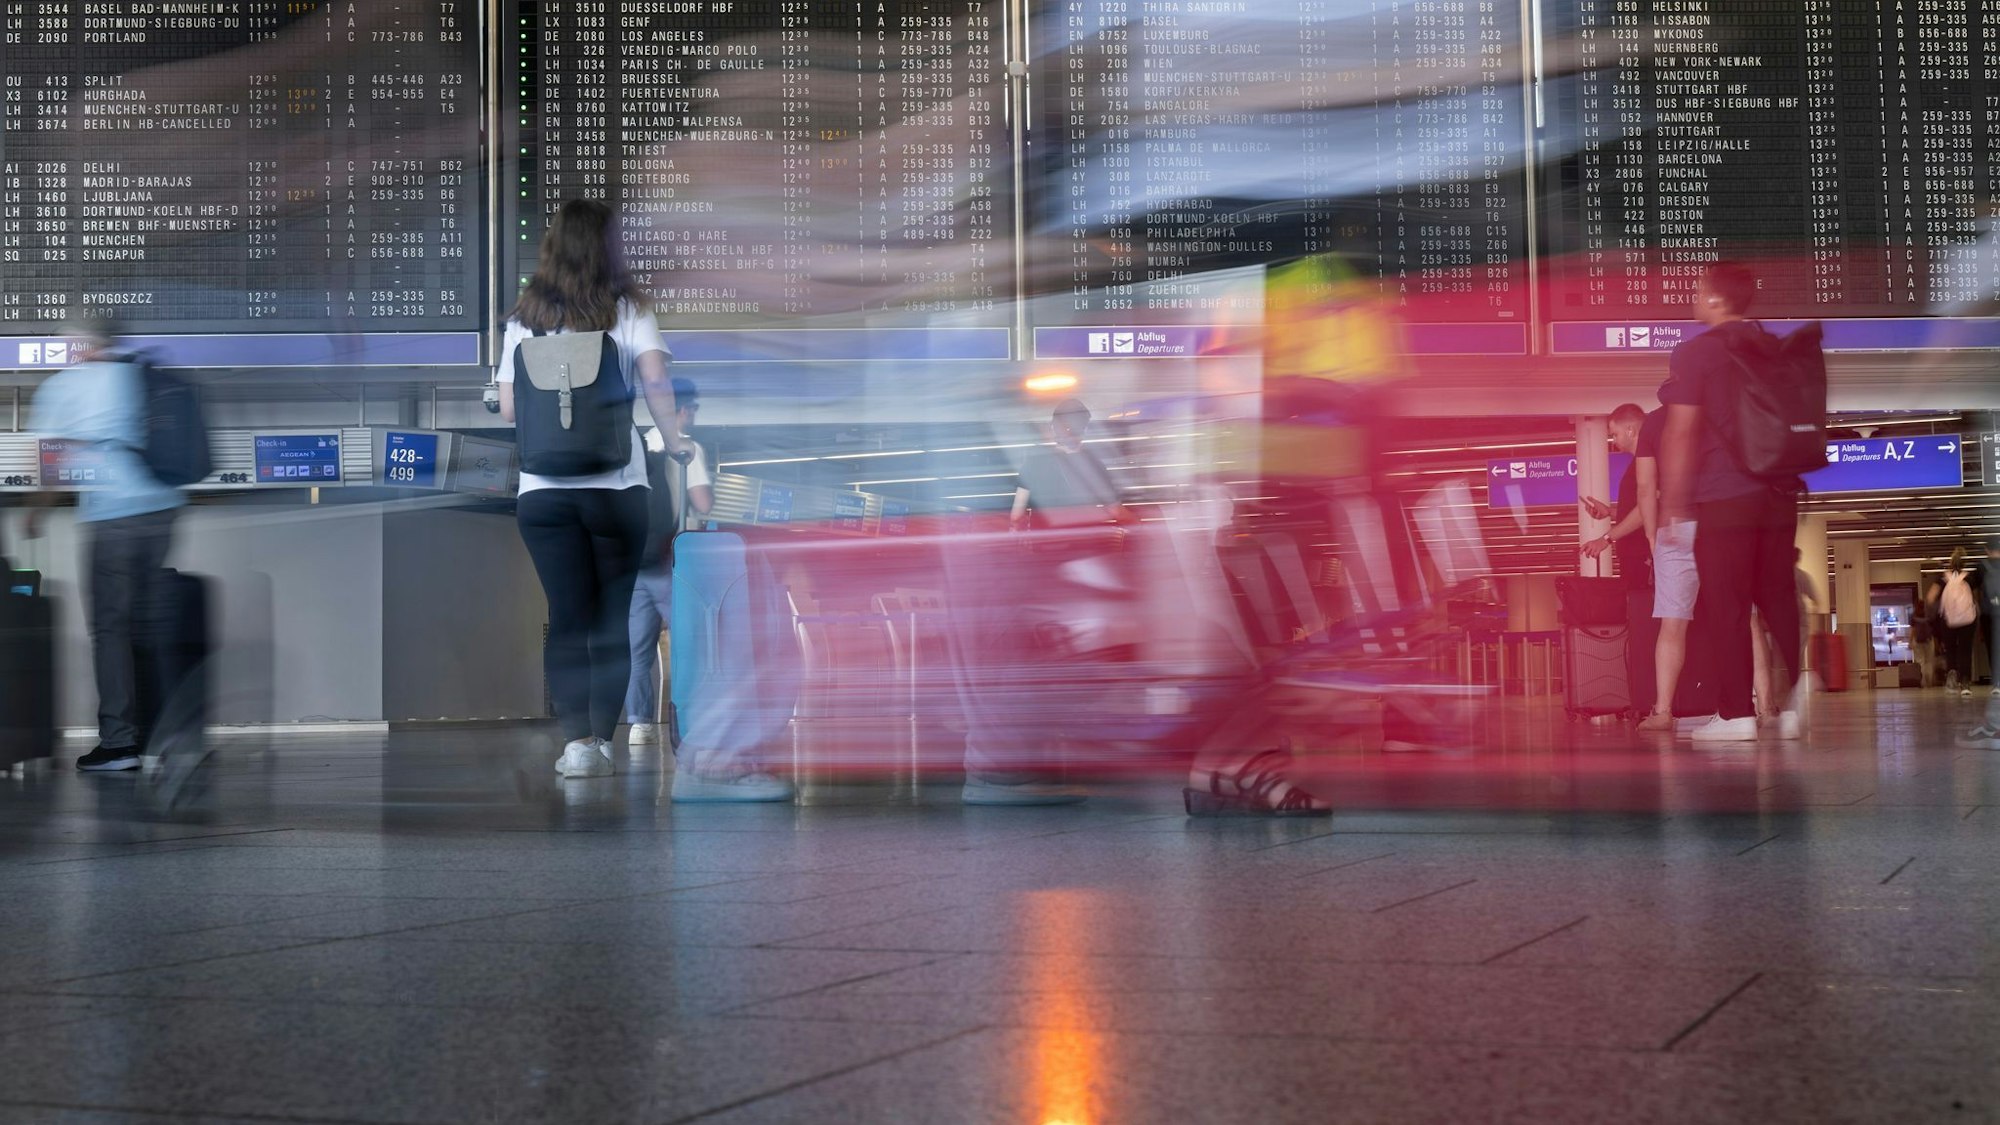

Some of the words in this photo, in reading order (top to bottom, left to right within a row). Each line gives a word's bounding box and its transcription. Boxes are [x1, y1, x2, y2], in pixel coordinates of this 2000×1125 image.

[7, 4, 22, 15] LH
[38, 3, 68, 15] 3544
[84, 3, 122, 14] BASEL
[621, 2, 703, 13] DUESSELDORF
[712, 2, 734, 13] HBF
[1580, 1, 1594, 12] LH
[1616, 1, 1638, 12] 850
[1652, 1, 1708, 12] HELSINKI
[1917, 0, 1967, 11] 259-335
[545, 16, 560, 28] LX
[577, 16, 605, 28] 1083
[621, 16, 650, 28] GENF
[900, 16, 952, 27] 259-335
[967, 16, 989, 27] A16
[1143, 15, 1179, 26] BASEL
[1653, 15, 1711, 26] LISSABON
[6, 32, 21, 44] DE
[38, 32, 68, 43] 2090
[84, 32, 146, 43] PORTLAND
[372, 31, 424, 42] 773-786
[440, 31, 462, 42] B43
[621, 30, 643, 42] LOS
[651, 30, 704, 42] ANGELES
[1143, 30, 1209, 41] LUXEMBURG
[1653, 29, 1704, 39] MYKONOS
[727, 45, 757, 56] POLO
[1654, 42, 1719, 53] NUERNBERG
[621, 59, 659, 70] PARIS
[697, 59, 711, 70] DE
[719, 59, 764, 70] GAULLE
[1143, 58, 1173, 69] WIEN
[1654, 56, 1676, 67] NEW
[84, 75, 122, 86] SPLIT
[621, 73, 681, 84] BRUESSEL
[1654, 70, 1720, 81] VANCOUVER
[6, 90, 21, 102] X3
[37, 90, 68, 101] 6102
[84, 90, 146, 101] HURGHADA
[371, 88, 424, 100] 954-955
[440, 88, 454, 100] E4
[622, 87, 720, 99] FUERTEVENTURA
[1144, 86, 1240, 97] KORFU/KERKYRA
[1655, 84, 1718, 95] STUTTGART
[1727, 84, 1748, 95] HBF
[621, 101, 689, 113] KATTOWITZ
[1144, 100, 1209, 111] BANGALORE
[1656, 98, 1677, 109] DUS
[1778, 97, 1799, 108] HBF
[1145, 114, 1167, 125] LAS
[1656, 112, 1713, 122] HANNOVER
[84, 119, 130, 130] BERLIN
[1145, 128, 1196, 139] HAMBURG
[1657, 126, 1720, 137] STUTTGART
[623, 144, 665, 156] TRIEST
[1189, 142, 1204, 153] DE
[1657, 139, 1750, 151] LEIPZIG/HALLE
[1658, 153, 1723, 164] BARCELONA
[5, 163, 19, 174] AI
[37, 162, 67, 174] 2026
[83, 162, 120, 173] DELHI
[371, 160, 423, 171] 747-751
[440, 160, 462, 171] B62
[621, 159, 675, 170] BOLOGNA
[1585, 168, 1600, 179] X3
[1615, 168, 1643, 179] 2806
[1658, 168, 1706, 178] FUNCHAL
[1924, 166, 1974, 177] 956-957
[621, 173, 690, 184] GOETEBORG
[1658, 181, 1708, 193] CALGARY
[83, 191, 153, 202] LJUBLJANA
[622, 187, 675, 199] BILLUND
[1146, 199, 1213, 210] HYDERABAD
[1659, 195, 1710, 206] DRESDEN
[621, 202, 713, 213] POZNAN/POSEN
[1257, 212, 1279, 223] HBF
[1587, 210, 1602, 221] LH
[1624, 210, 1645, 221] 422
[1659, 209, 1703, 221] BOSTON
[83, 220, 130, 231] BREMEN
[622, 216, 652, 227] PRAG
[1147, 227, 1236, 238] PHILADELPHIA
[1660, 223, 1703, 234] DENVER
[82, 234, 145, 246] MUENCHEN
[698, 230, 727, 241] HARE
[1661, 237, 1718, 248] BUKAREST
[83, 249, 145, 260] SINGAPUR
[751, 244, 773, 255] HBF
[1147, 256, 1190, 266] MUMBAI
[1661, 251, 1719, 262] LISSABON
[1928, 249, 1977, 260] 717-719
[1147, 269, 1185, 281] DELHI
[1147, 284, 1200, 295] ZUERICH
[4, 294, 20, 305] LH
[37, 293, 66, 305] 1360
[82, 293, 152, 304] BYDGOSZCZ
[371, 290, 424, 302] 259-335
[1074, 299, 1089, 310] LH
[1104, 299, 1133, 310] 3652
[1148, 298, 1193, 309] BREMEN
[1137, 331, 1166, 343] Abflug
[1653, 326, 1681, 338] Abflug
[1137, 344, 1185, 355] Departures
[256, 440, 287, 448] Check-in
[390, 448, 424, 463] 428-
[1841, 443, 1866, 453] Abflug
[1883, 441, 1915, 462] A,Z
[1841, 453, 1881, 463] Departures
[1528, 461, 1551, 470] Abflug
[220, 473, 247, 483] 464
[389, 467, 415, 482] 499
[1529, 470, 1565, 479] Departures
[4, 475, 33, 486] 465
